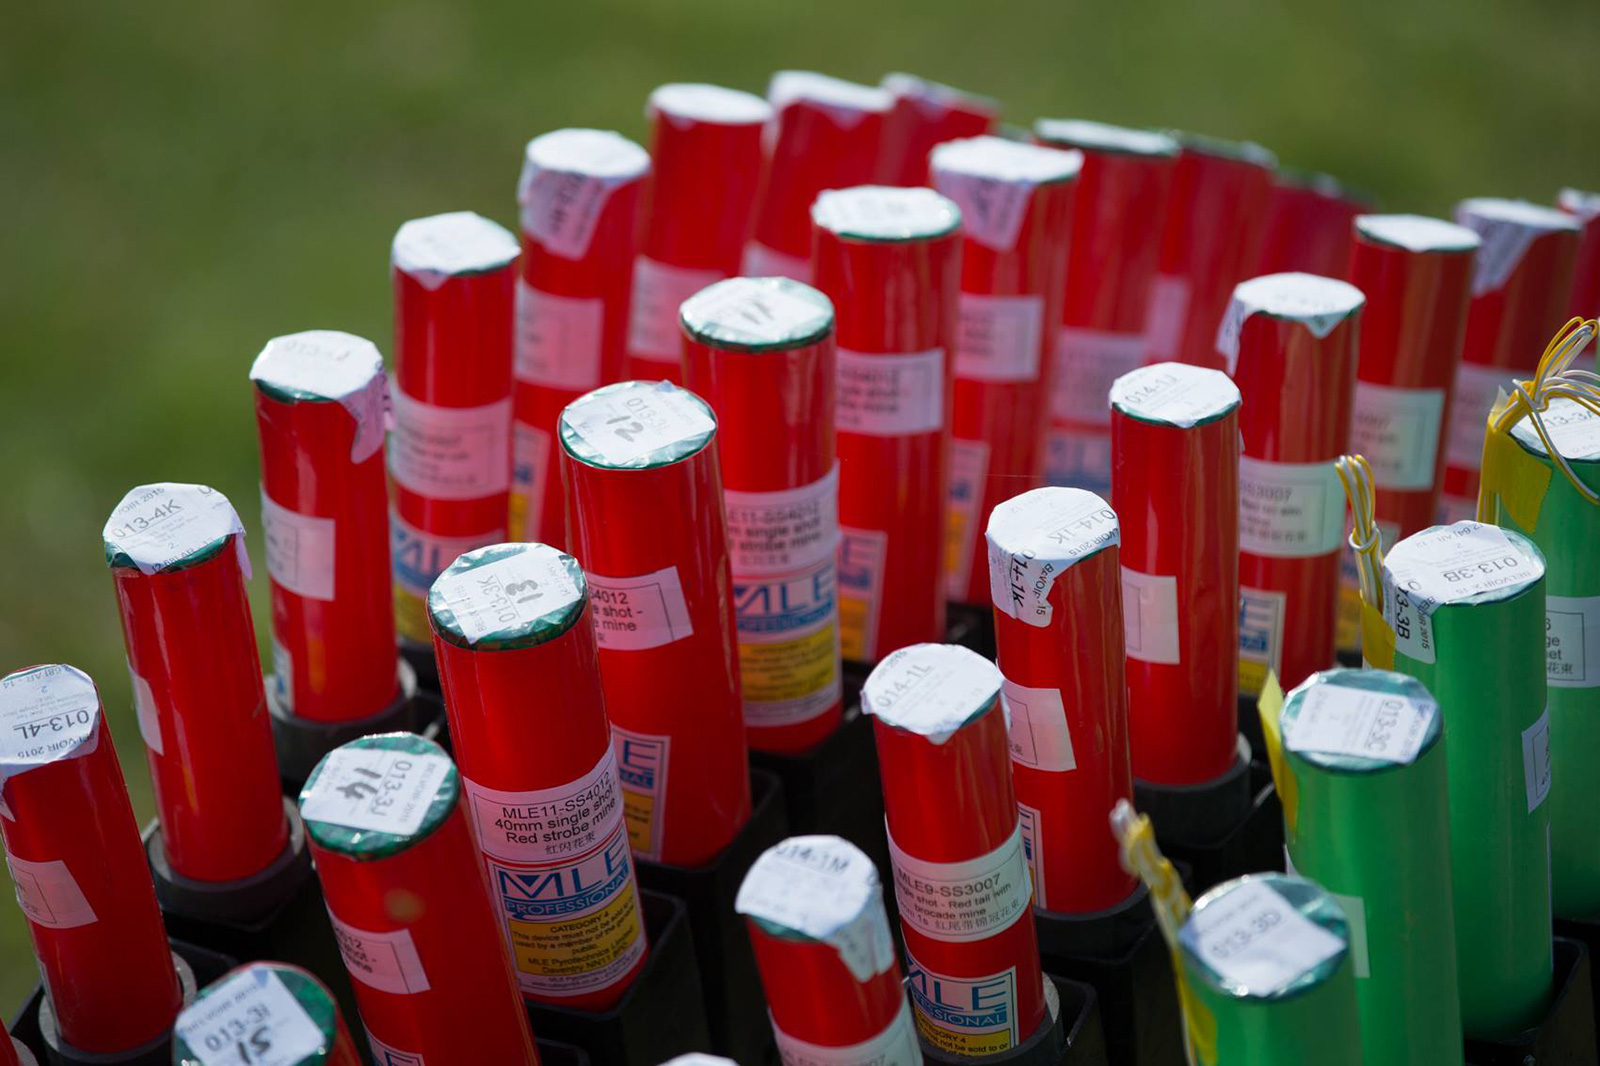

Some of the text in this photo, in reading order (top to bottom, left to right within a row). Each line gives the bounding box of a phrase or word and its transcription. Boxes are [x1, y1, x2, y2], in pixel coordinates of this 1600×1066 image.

[606, 415, 644, 443] 12
[141, 487, 166, 502] 2015
[111, 499, 183, 540] 013-4K
[1047, 508, 1116, 544] 014-1K
[1068, 540, 1093, 556] 2015
[1443, 556, 1519, 583] 013-3B
[476, 575, 516, 623] 013-3K
[505, 579, 544, 604] 13
[602, 604, 634, 618] shot
[602, 619, 637, 632] mine
[876, 663, 932, 708] 014-1L
[13, 709, 91, 740] 013-4L
[17, 745, 45, 759] 2015
[368, 759, 413, 817] 013-3J
[502, 771, 610, 820] MLE11-SS4012
[495, 818, 543, 832] 40mm
[547, 806, 590, 827] single
[593, 786, 613, 810] shot
[506, 797, 616, 844] Red strobe mine
[498, 832, 626, 899] MLE
[897, 867, 1001, 898] MLE9-SS3007
[914, 903, 987, 920] brocade mine
[916, 895, 938, 908] shot
[948, 900, 972, 909] Red
[550, 913, 602, 934] CATEGORY
